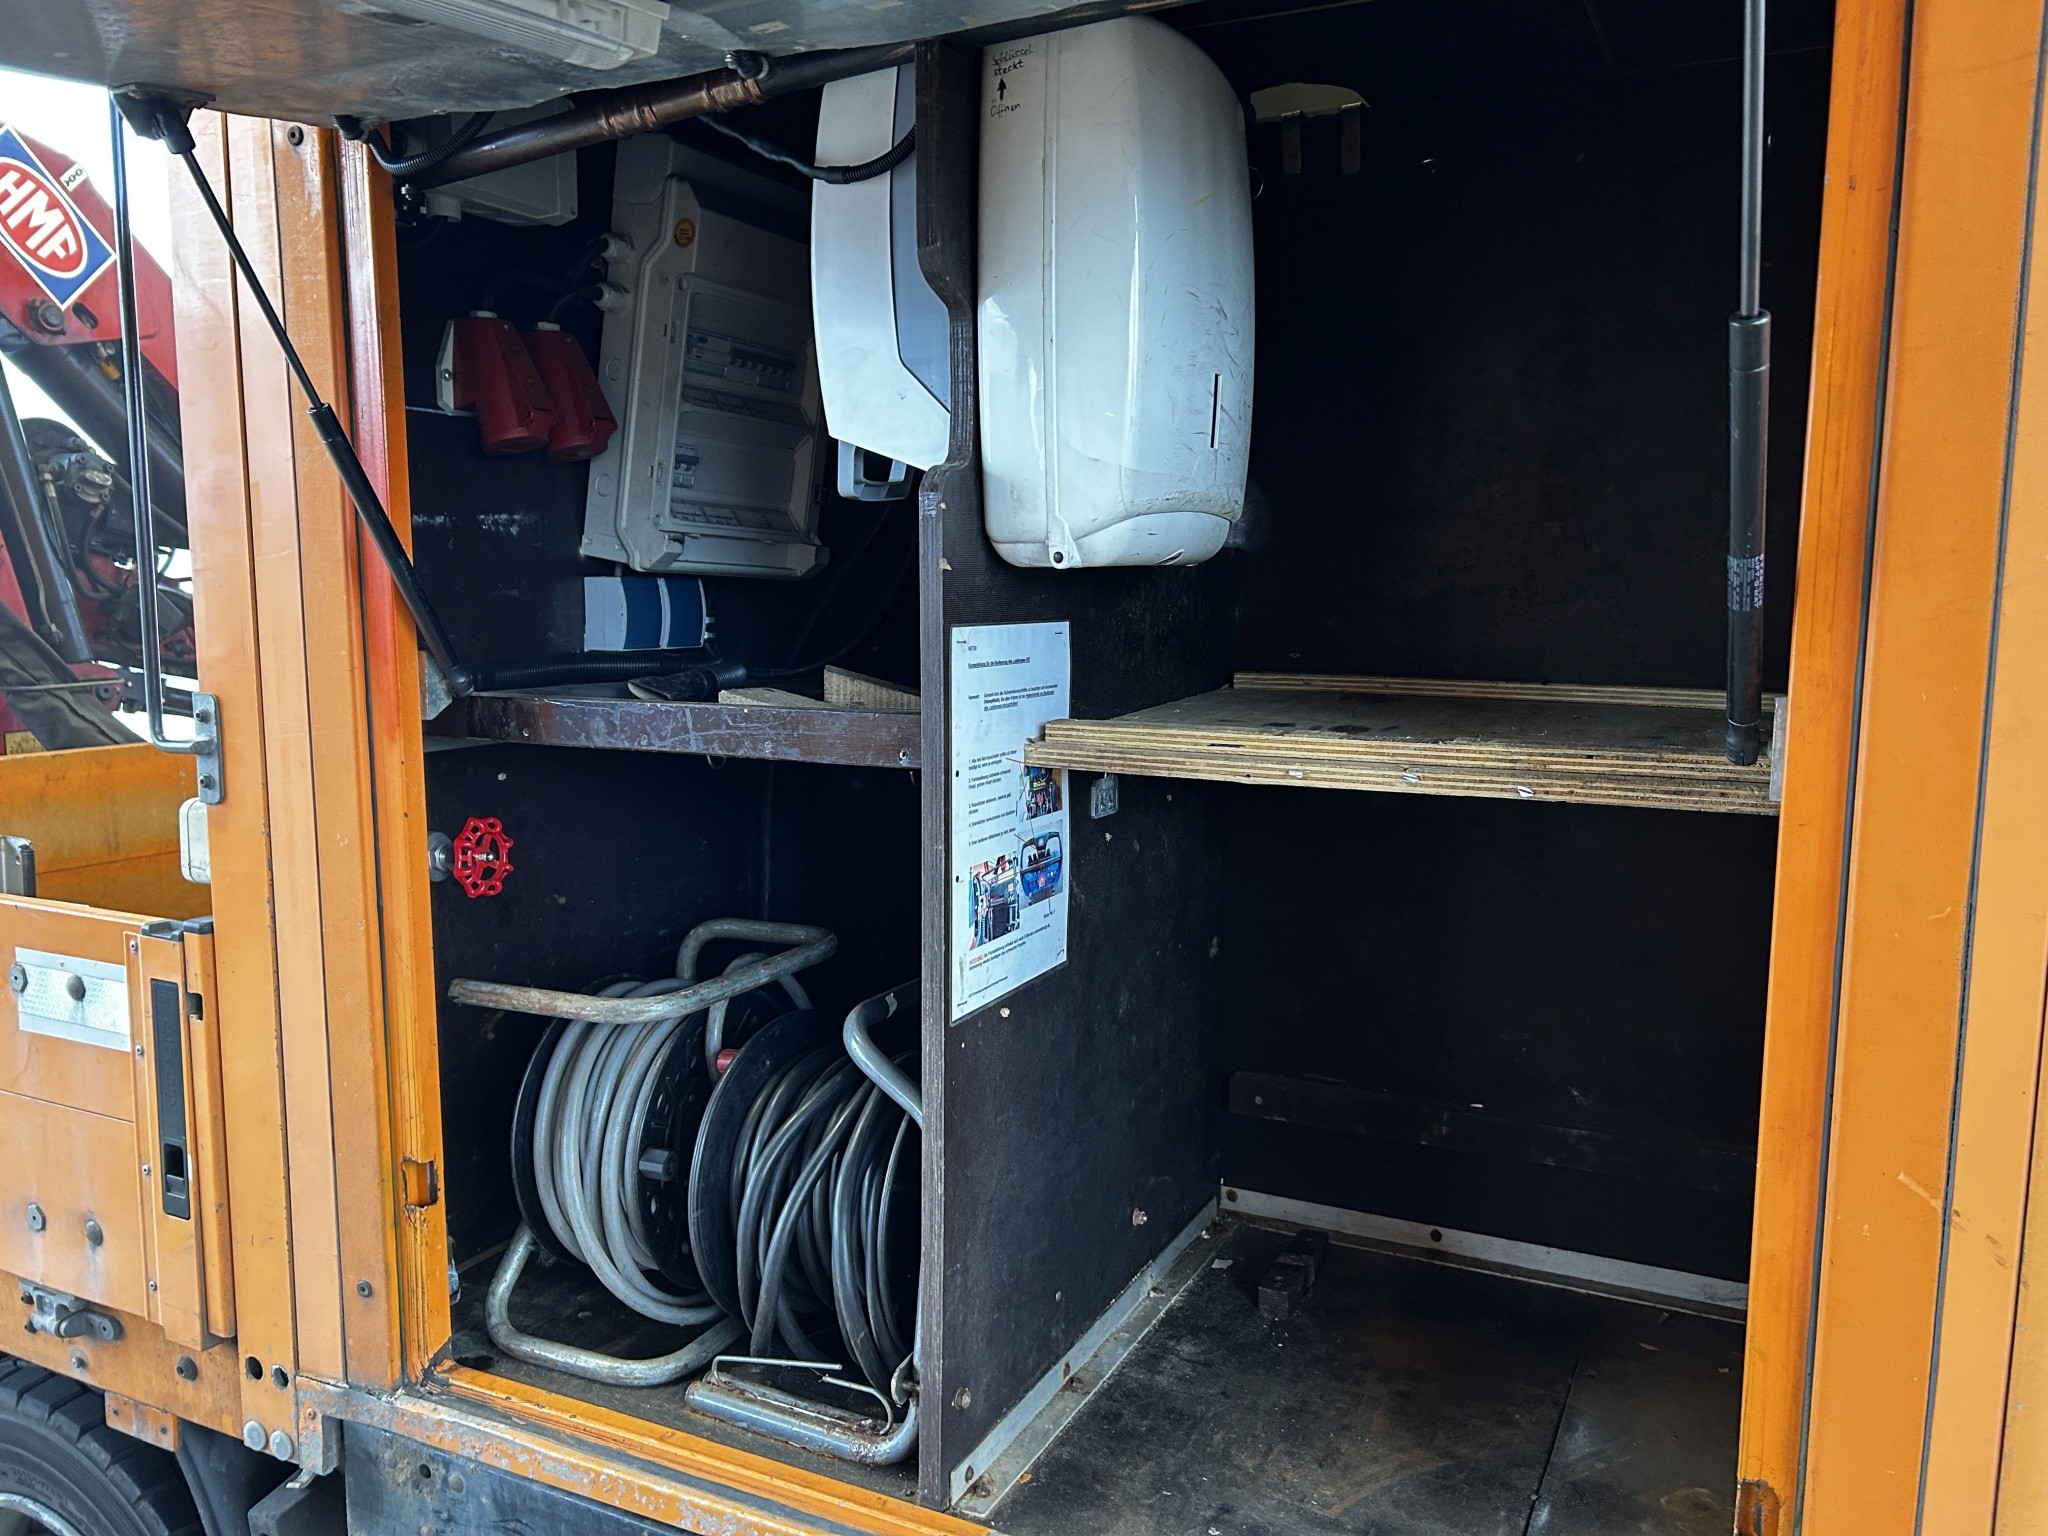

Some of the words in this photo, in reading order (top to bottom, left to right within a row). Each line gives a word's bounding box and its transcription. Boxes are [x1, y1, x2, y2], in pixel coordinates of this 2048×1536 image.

[993, 43, 1034, 66] Schlüssel
[993, 59, 1024, 76] steckt
[991, 99, 1021, 118] Öffnen
[0, 169, 78, 260] HMF
